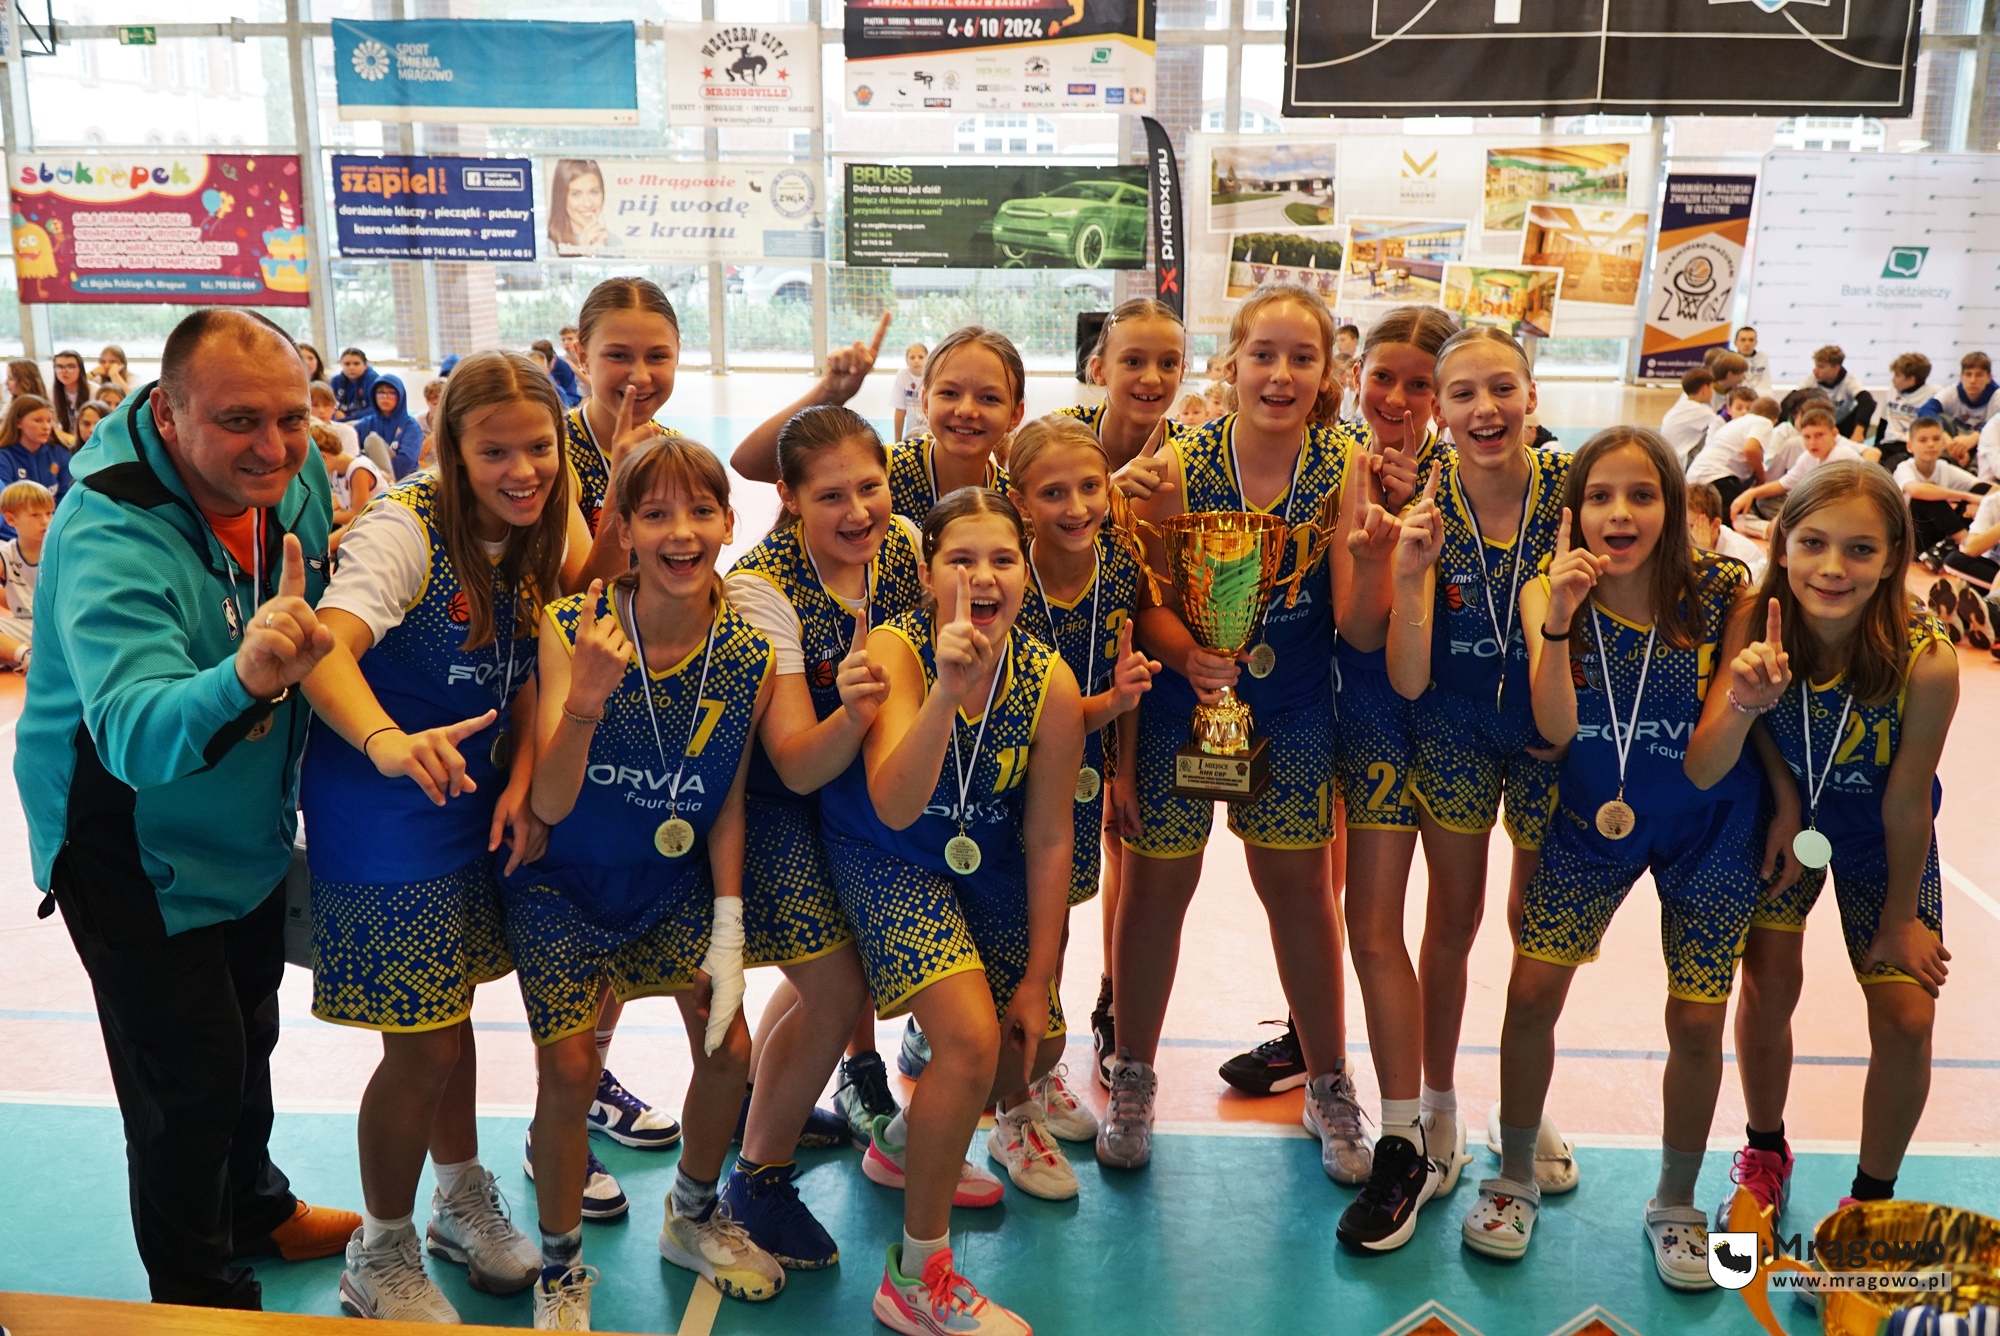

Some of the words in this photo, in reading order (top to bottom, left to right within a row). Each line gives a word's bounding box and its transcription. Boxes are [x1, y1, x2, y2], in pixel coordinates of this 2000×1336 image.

[947, 16, 1043, 38] 4-6/10/2024
[396, 43, 429, 56] SPORT
[701, 27, 758, 58] WESTERN
[761, 32, 789, 60] CITY
[396, 56, 440, 68] ZMIENIA
[398, 69, 453, 82] MRĄGOWO
[705, 88, 788, 97] MRONGOVILLE
[340, 166, 436, 199] szapiel
[617, 176, 634, 186] w
[639, 174, 736, 191] Mrągowie
[852, 167, 912, 184] BRUSS
[852, 184, 880, 194] Dołącz
[880, 185, 892, 193] do
[908, 185, 921, 196] już
[338, 204, 392, 217] dorabianie
[394, 206, 426, 220] kluczy
[434, 206, 480, 220] pieczątki
[488, 207, 530, 222] puchary
[618, 195, 660, 216] pij
[670, 196, 750, 218] wodę
[354, 224, 382, 235] ksero
[384, 224, 471, 237] wielkoformatowe
[480, 228, 518, 240] grawer
[626, 225, 641, 238] z
[650, 222, 736, 239] kranu
[1841, 285, 1872, 297] Bank
[1876, 285, 1951, 300] Spółdzielczy
[1451, 572, 1481, 584] MKS
[1105, 608, 1128, 659] 3
[686, 698, 726, 757] 7
[1834, 710, 1890, 766] 21
[588, 764, 705, 794] ORVIA
[626, 791, 702, 812] faurecia
